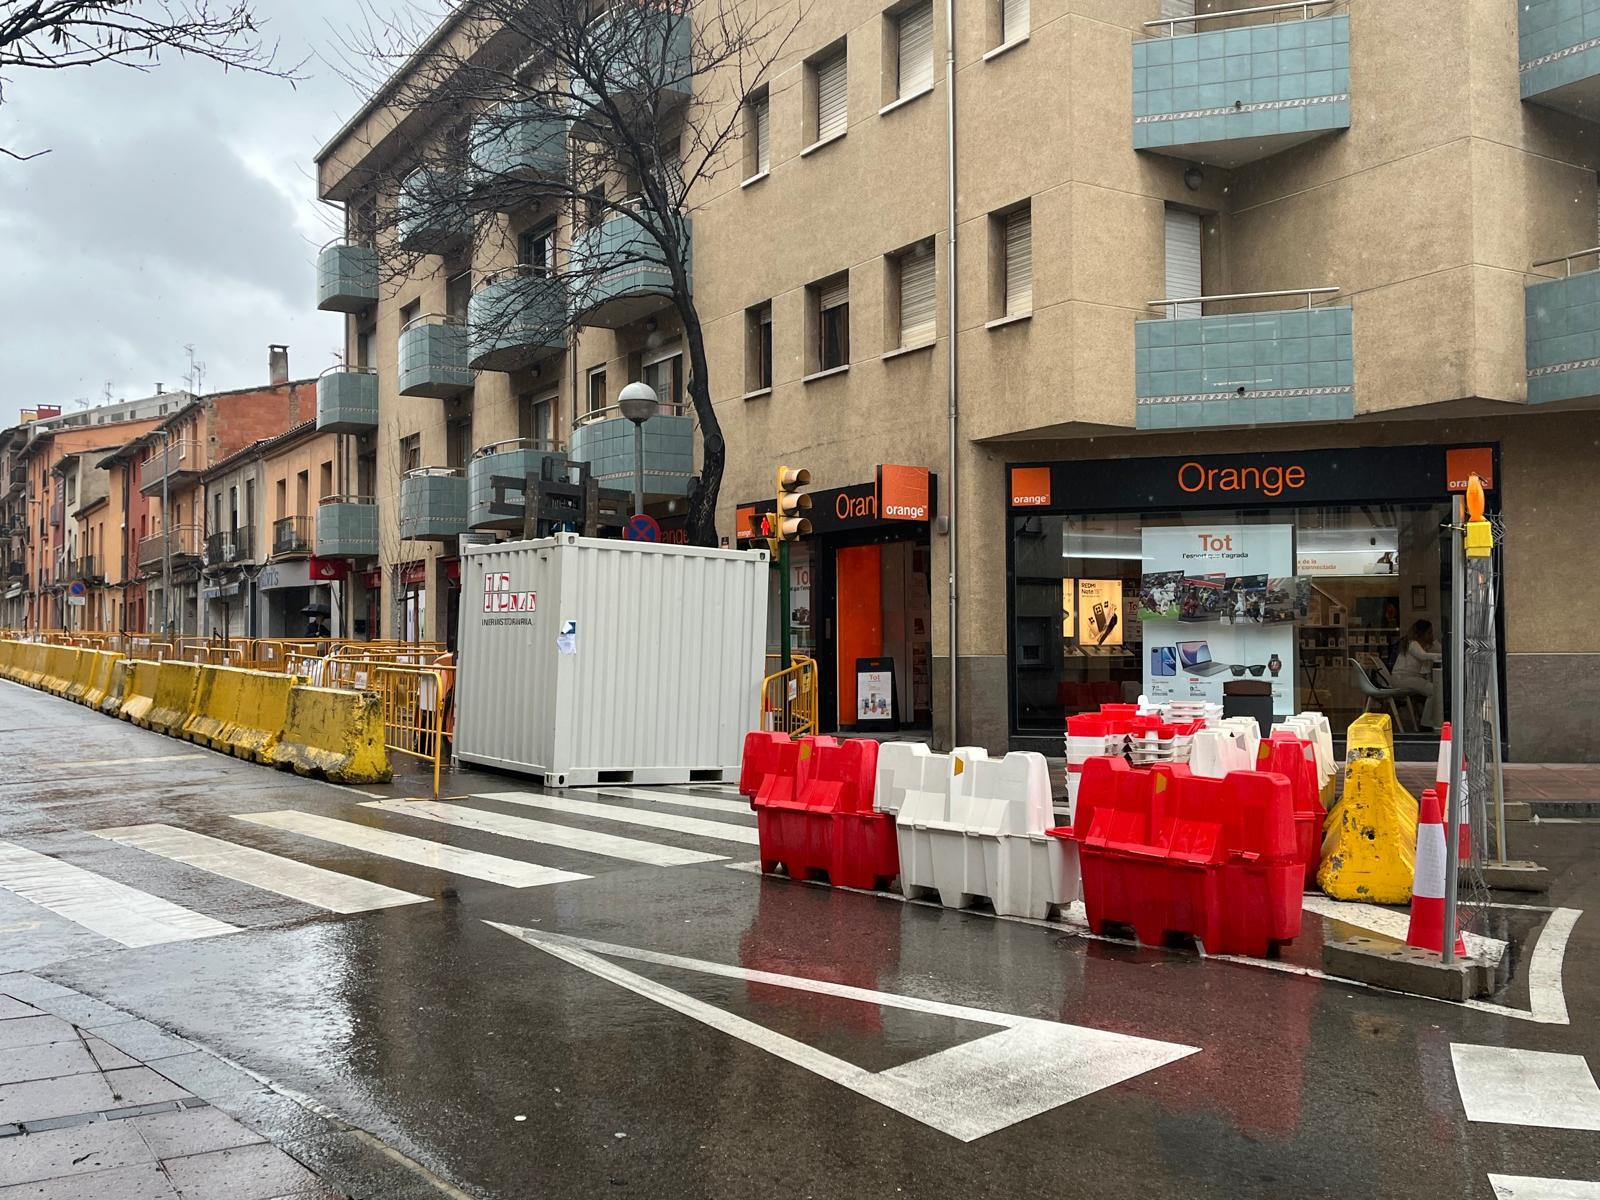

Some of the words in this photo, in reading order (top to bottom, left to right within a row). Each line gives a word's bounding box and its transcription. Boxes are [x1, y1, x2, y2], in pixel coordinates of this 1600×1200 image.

[1178, 462, 1306, 497] Orange
[1013, 495, 1048, 505] orange
[886, 505, 925, 518] orange
[1198, 534, 1232, 551] Tot
